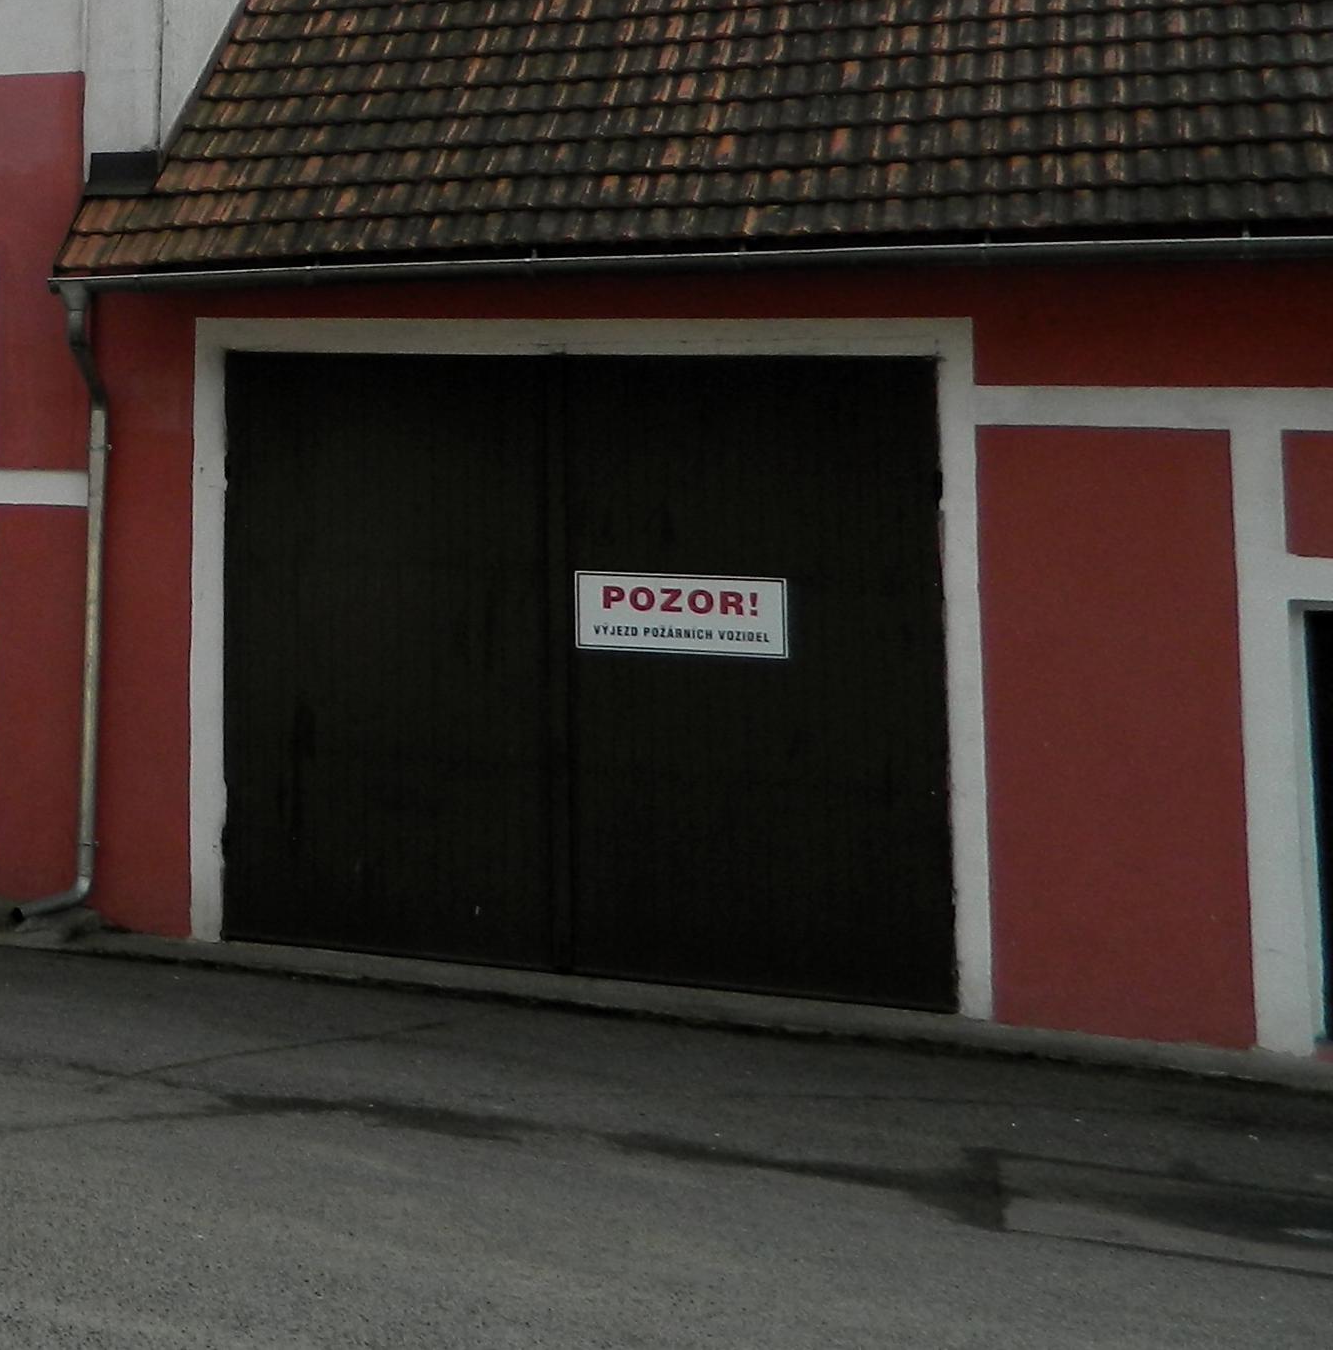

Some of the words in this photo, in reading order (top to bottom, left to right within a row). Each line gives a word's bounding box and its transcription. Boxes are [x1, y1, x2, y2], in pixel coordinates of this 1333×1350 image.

[602, 585, 758, 617] POZOR!
[593, 622, 638, 637] VÝJEZD
[643, 624, 713, 640] POŽÁRNÍCH
[718, 630, 770, 643] VOZIDEL
